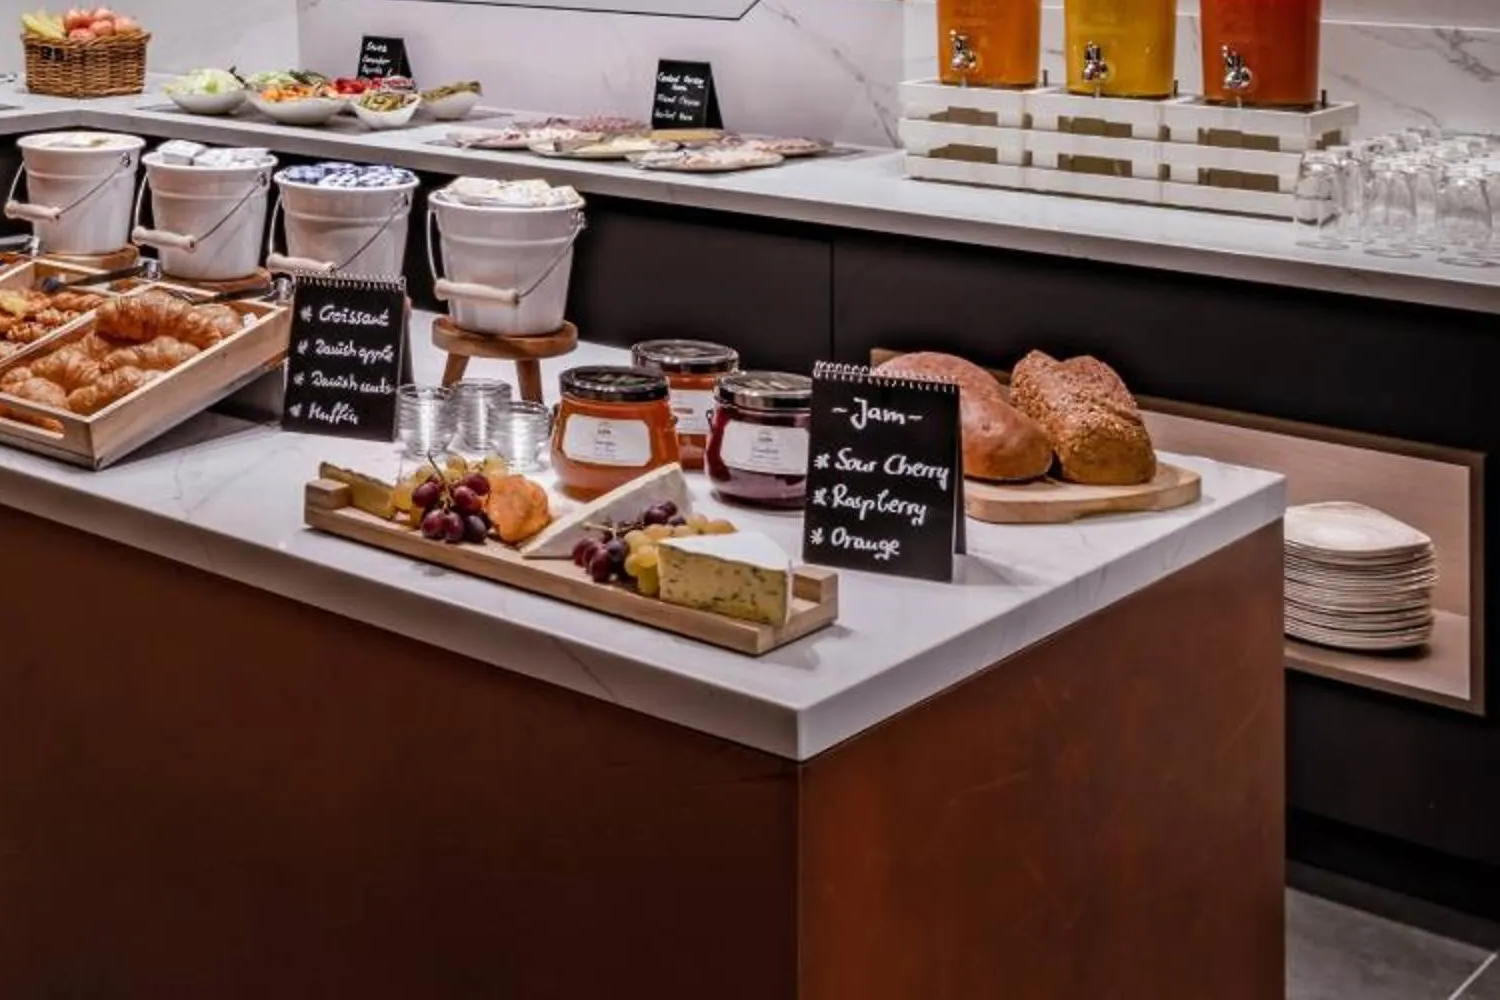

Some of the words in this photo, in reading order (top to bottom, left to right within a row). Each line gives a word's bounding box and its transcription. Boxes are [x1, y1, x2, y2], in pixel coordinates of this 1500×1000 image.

[318, 304, 390, 327] Croissant
[315, 338, 357, 356] Danish
[358, 344, 394, 364] apple
[310, 370, 357, 391] Danish
[307, 401, 359, 425] Muffin
[835, 446, 878, 474] Sour
[883, 454, 950, 491] Cherry
[831, 527, 900, 561] Orange
